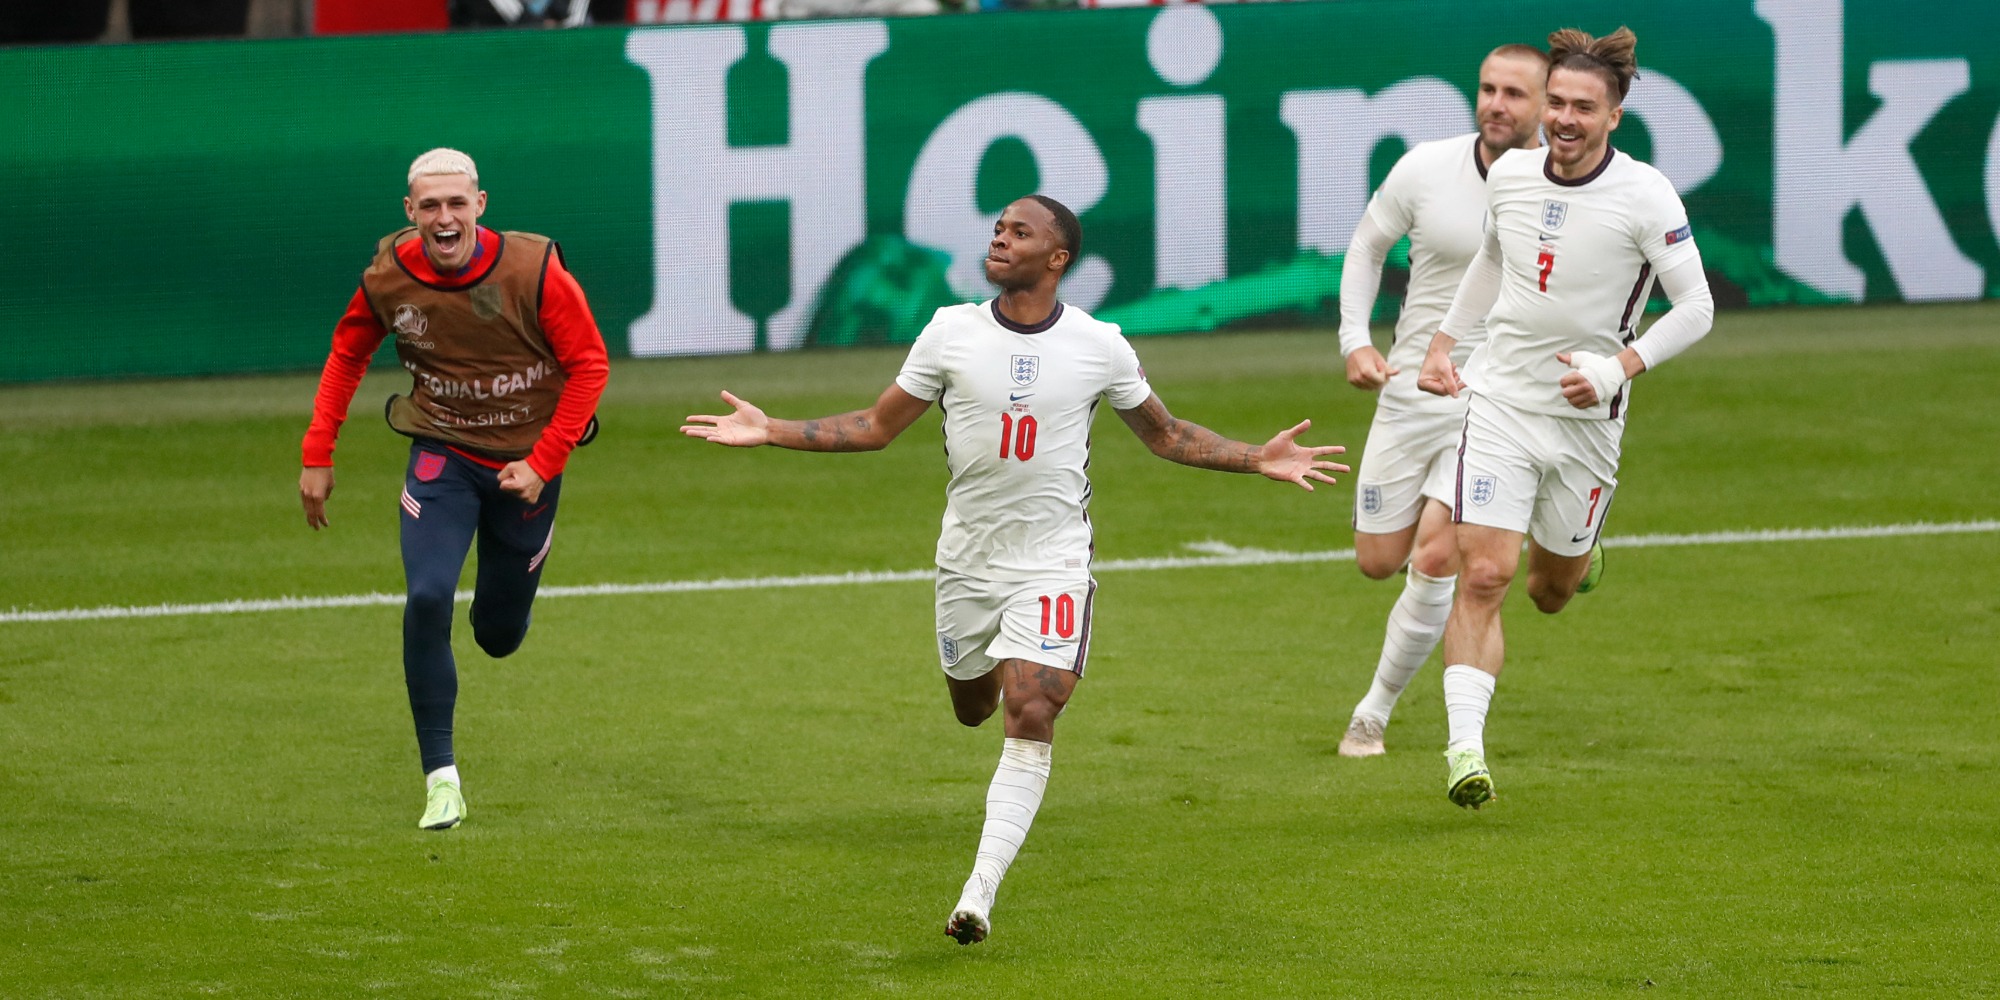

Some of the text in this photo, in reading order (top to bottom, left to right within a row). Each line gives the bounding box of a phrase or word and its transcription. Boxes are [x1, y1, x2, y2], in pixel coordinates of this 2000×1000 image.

[1537, 252, 1555, 293] 7
[999, 412, 1037, 462] 10
[1585, 486, 1602, 528] 7
[1039, 593, 1074, 638] 10
